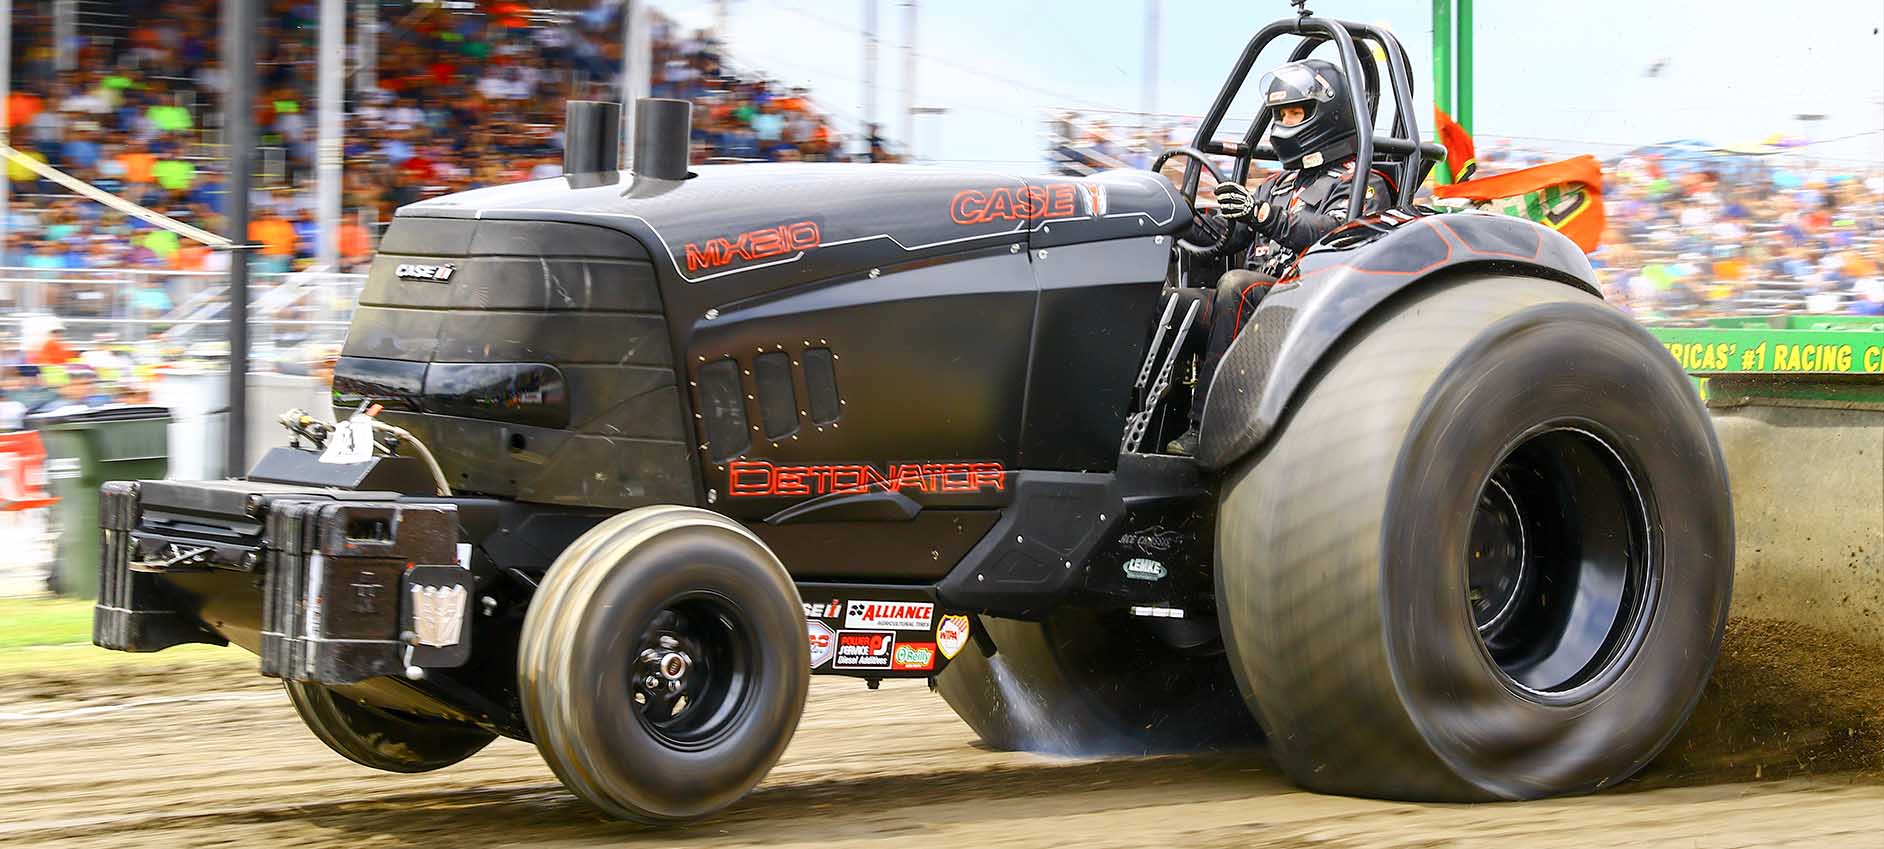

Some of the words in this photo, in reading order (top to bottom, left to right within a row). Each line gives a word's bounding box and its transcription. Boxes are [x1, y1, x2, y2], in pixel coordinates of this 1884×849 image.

[950, 184, 1075, 225] CASE
[684, 221, 821, 272] MX210
[395, 264, 437, 279] CASE
[1663, 343, 1737, 370] RICAS'
[1740, 340, 1767, 371] #1
[1772, 344, 1853, 373] RACING
[803, 603, 825, 617] SE
[862, 604, 932, 621] ALLIANCE
[840, 636, 870, 645] POWER
[838, 645, 870, 656] SERVICE
[837, 655, 859, 665] Diesel
[858, 656, 888, 666] Additives
